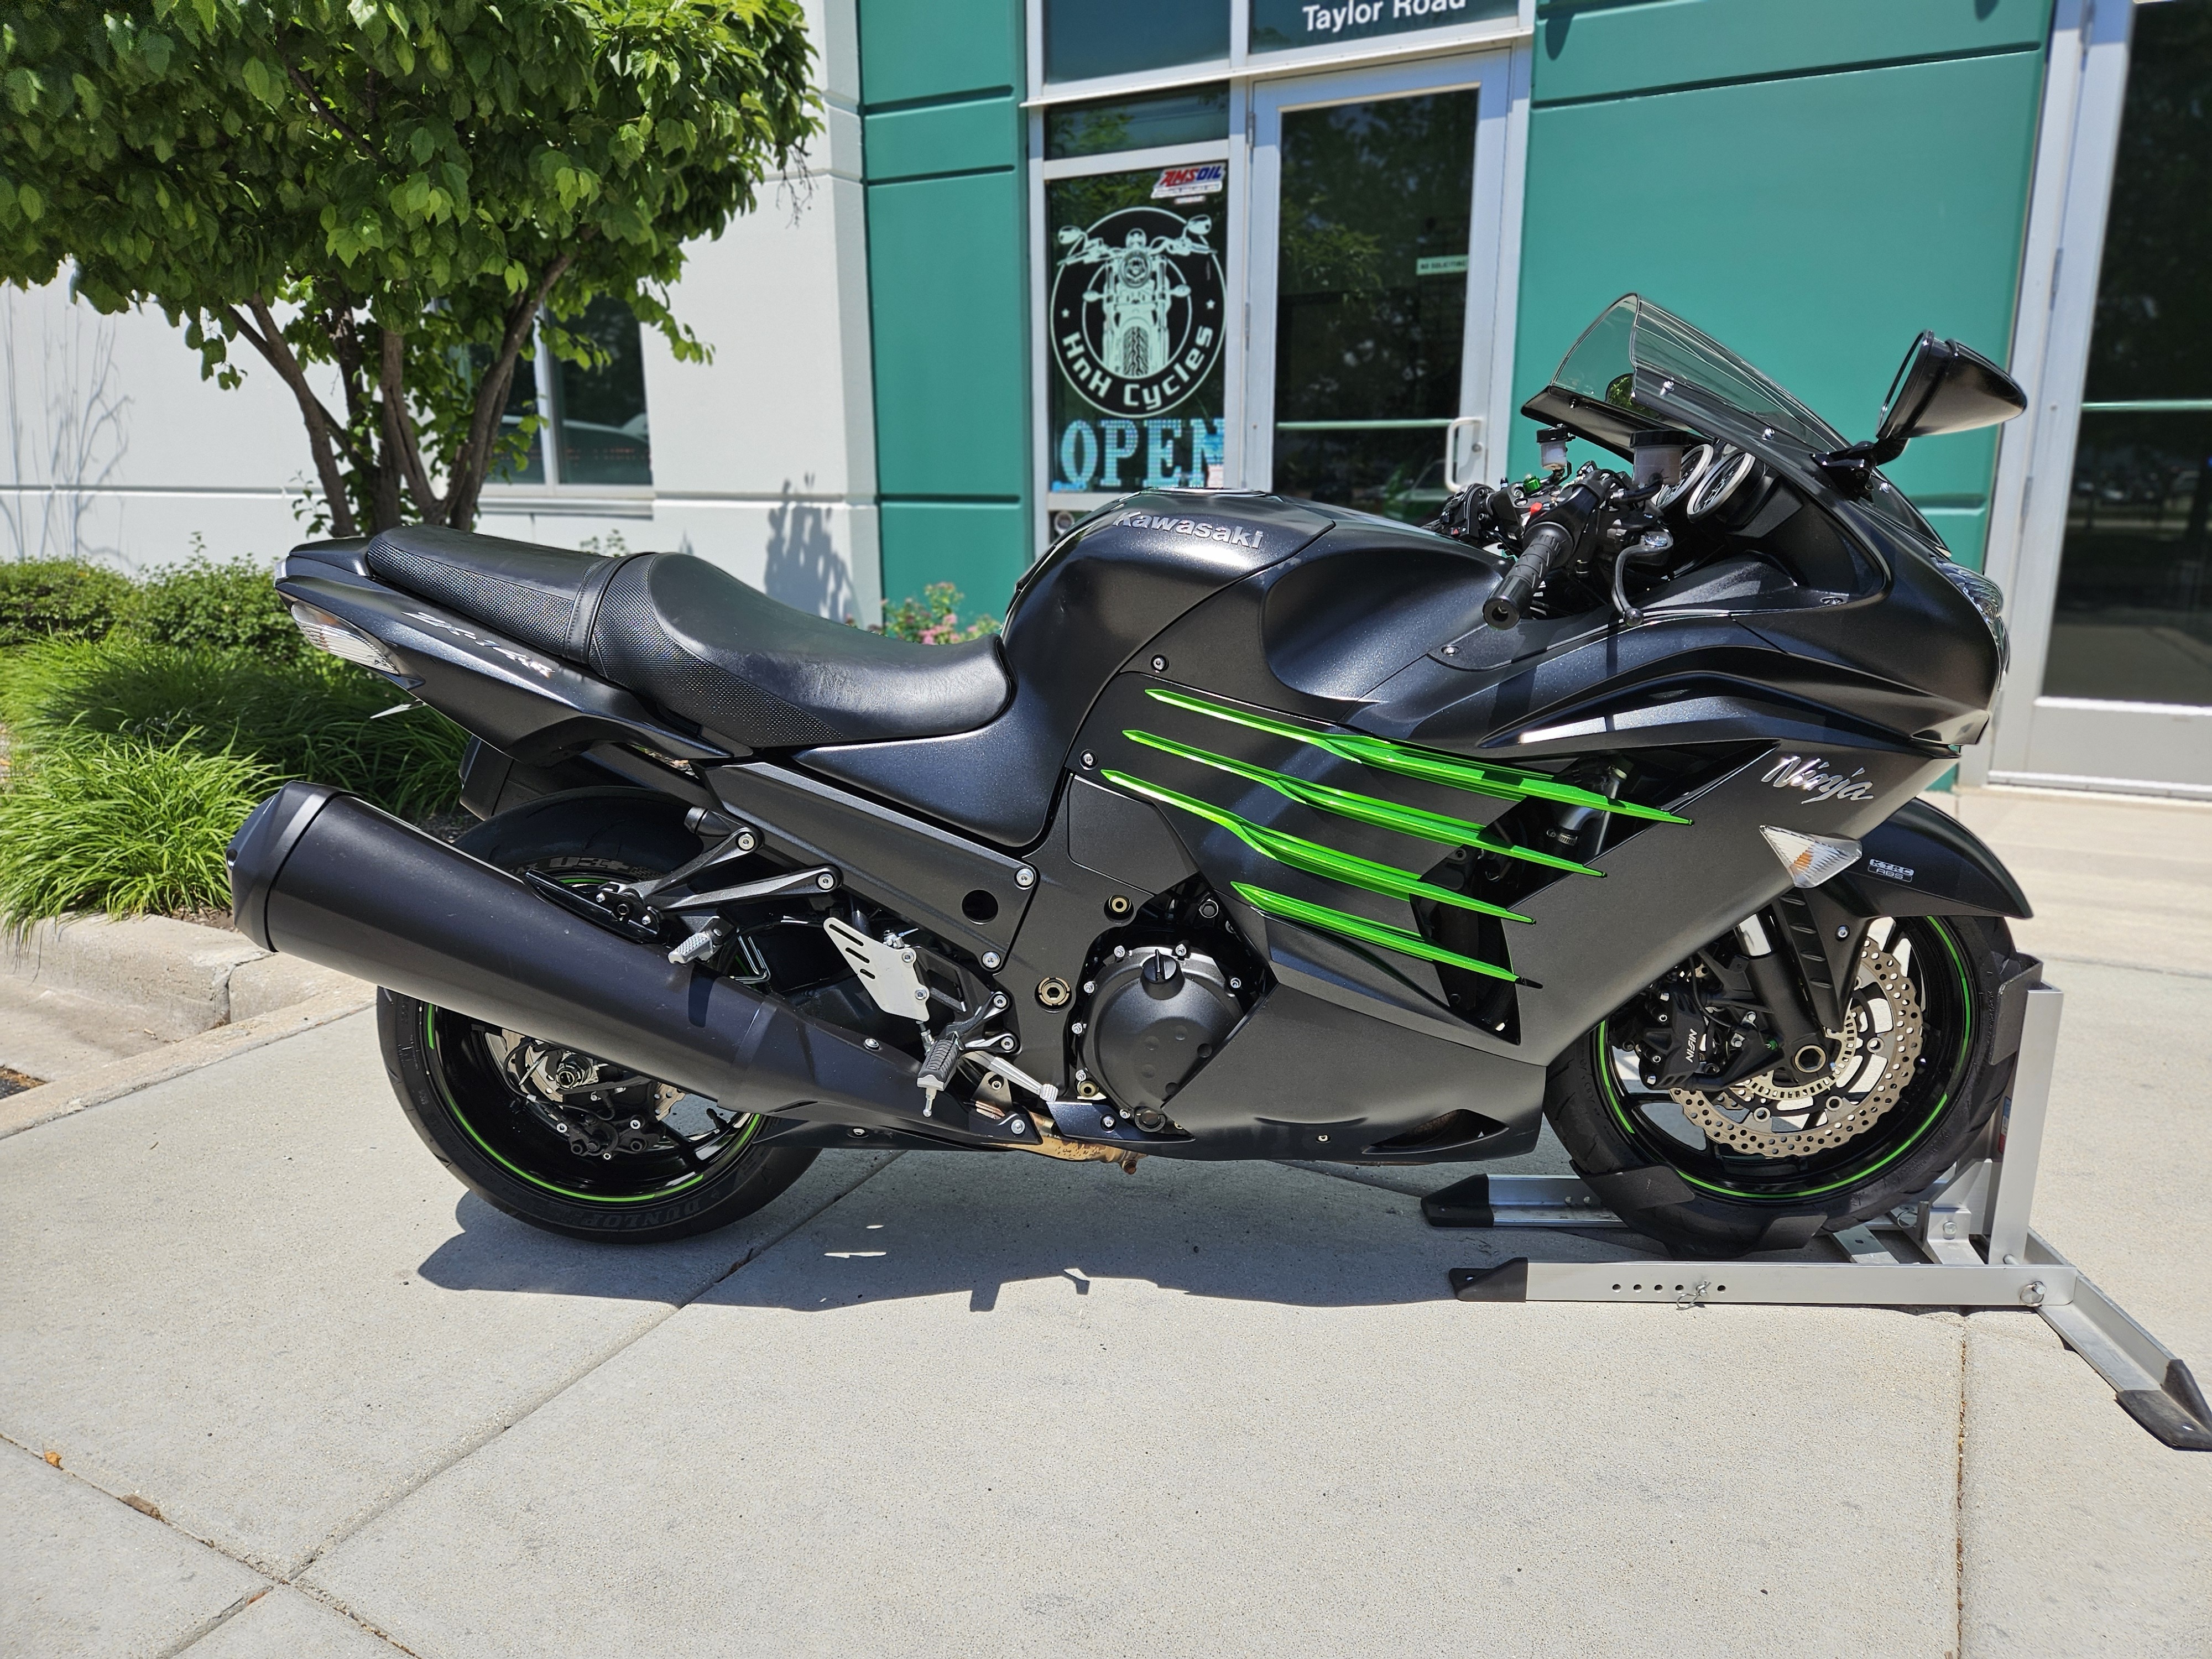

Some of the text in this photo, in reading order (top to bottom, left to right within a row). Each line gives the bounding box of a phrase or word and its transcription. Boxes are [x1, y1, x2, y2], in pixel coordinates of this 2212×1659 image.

[1302, 0, 1383, 33] Taylor
[1159, 165, 1222, 187] AMSOIL
[1062, 325, 1213, 411] HnH Cycles
[1061, 419, 1224, 488] OPEN
[1112, 510, 1264, 550] Kawasaki
[1761, 755, 1874, 805] Ninja
[1871, 859, 1912, 875] KTRC
[1876, 868, 1903, 879] ABS
[1686, 1028, 1698, 1063] NISSIN
[580, 1197, 702, 1228] DUNLOP
